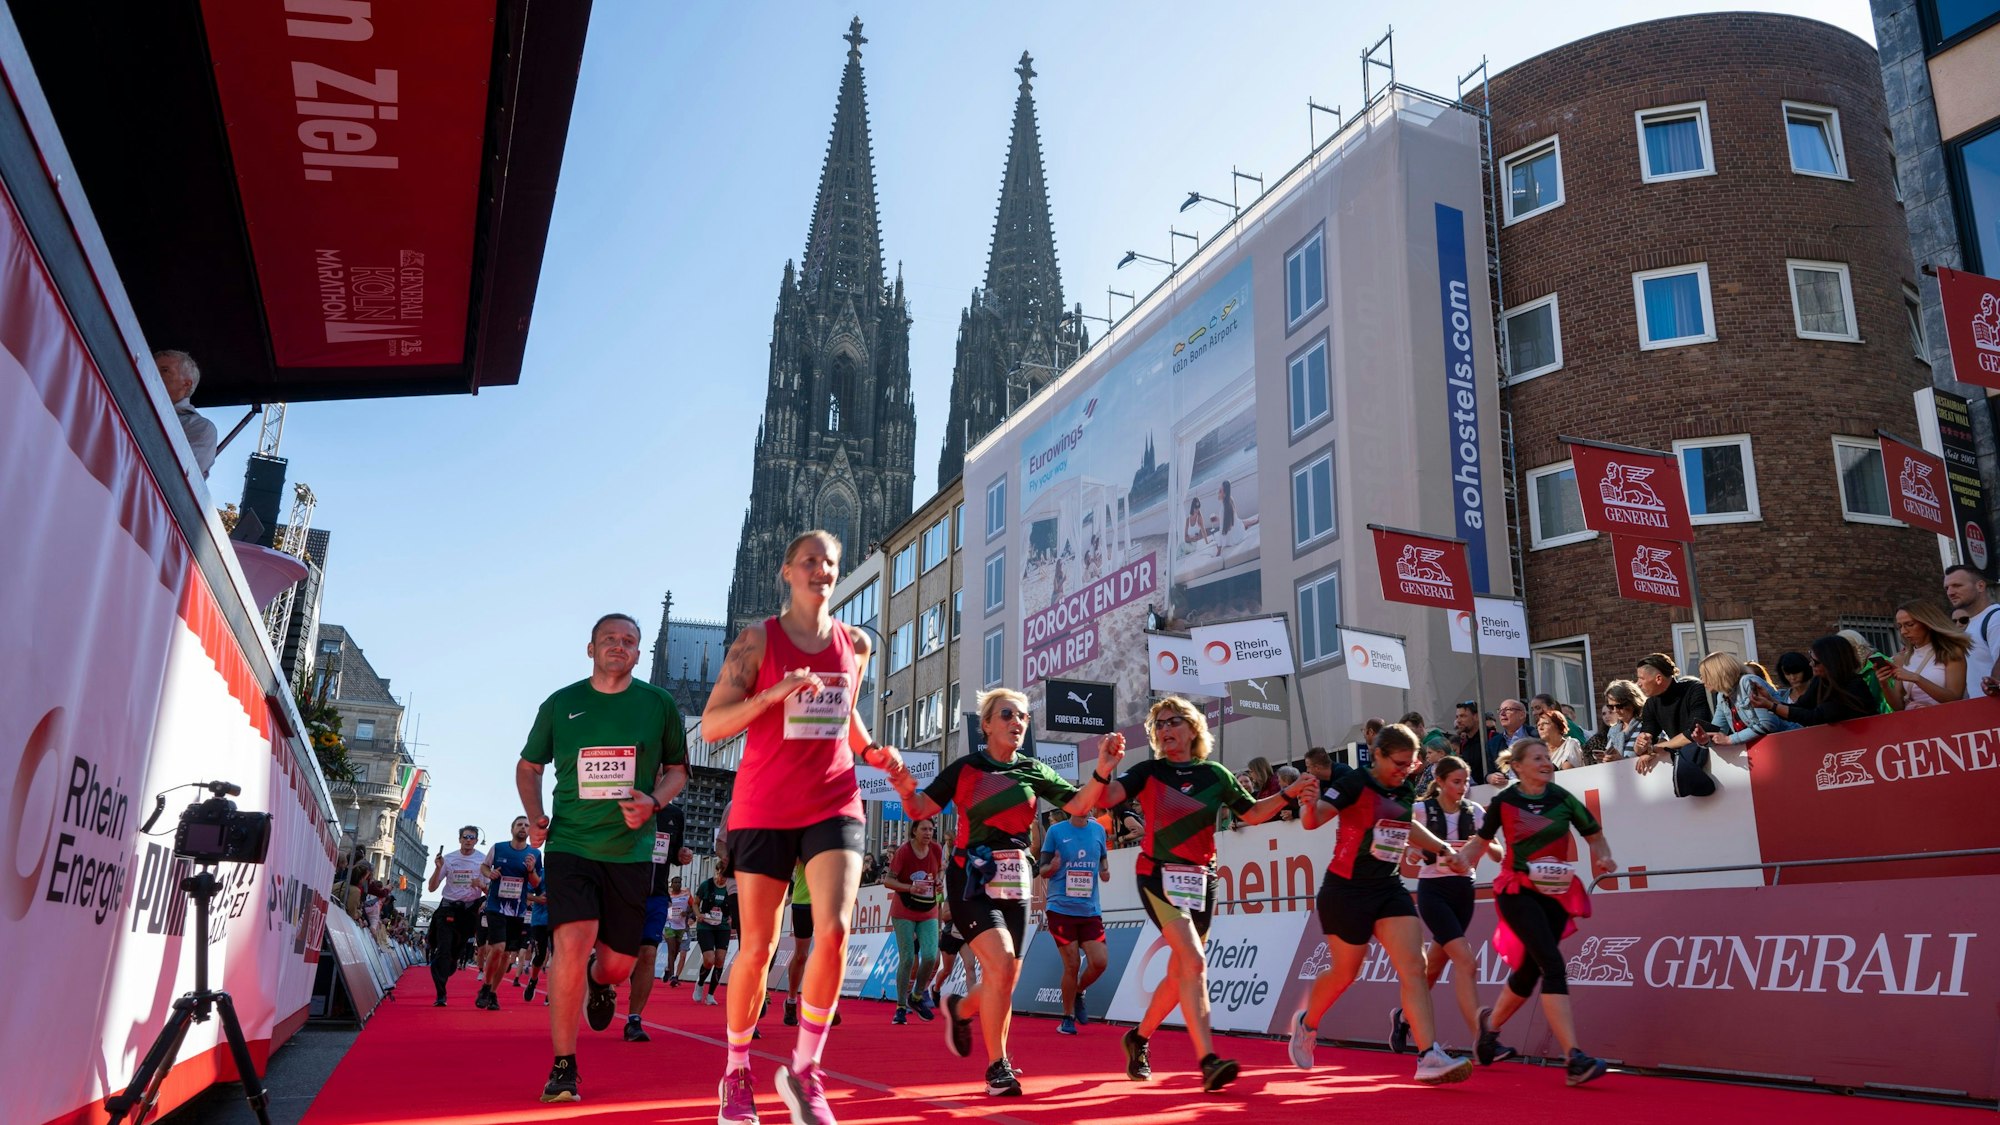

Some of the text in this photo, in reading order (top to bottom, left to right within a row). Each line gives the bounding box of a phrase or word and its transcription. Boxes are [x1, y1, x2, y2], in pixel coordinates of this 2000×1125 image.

[291, 61, 399, 182] Ziel.
[315, 249, 348, 321] MARATHON
[350, 267, 397, 321] KÖLN
[400, 267, 424, 320] GENERALI
[1173, 318, 1238, 376] Köln Bonn Airport
[1449, 280, 1482, 530] aohostels.com
[1955, 412, 1970, 427] WALL
[1030, 424, 1084, 475] Eurowings
[1945, 448, 1976, 465] Seit 2007
[1604, 507, 1670, 529] GENERALI
[1904, 499, 1943, 524] GENERALI
[1400, 581, 1456, 600] GENERALI
[1633, 580, 1680, 598] GENERALI
[1026, 560, 1152, 646] ZORÖCK EN D'R
[1482, 616, 1510, 628] Rhein
[1483, 626, 1521, 640] Energie
[1026, 629, 1095, 683] DOM REP
[1234, 638, 1269, 651] Rhein
[1236, 647, 1282, 661] Energie
[1370, 650, 1394, 662] Rhein
[1372, 659, 1402, 672] Energie
[1240, 699, 1282, 713] FOREVER. FASTER.
[1055, 714, 1105, 727] FOREVER. FASTER.
[585, 761, 626, 772] 21231
[1876, 728, 2000, 782] GENE
[906, 760, 935, 774] ssdorf
[63, 755, 129, 841] Rhein
[46, 832, 126, 926] Energie
[1644, 932, 1978, 996] GENERALI
[1206, 973, 1269, 1012] ergie
